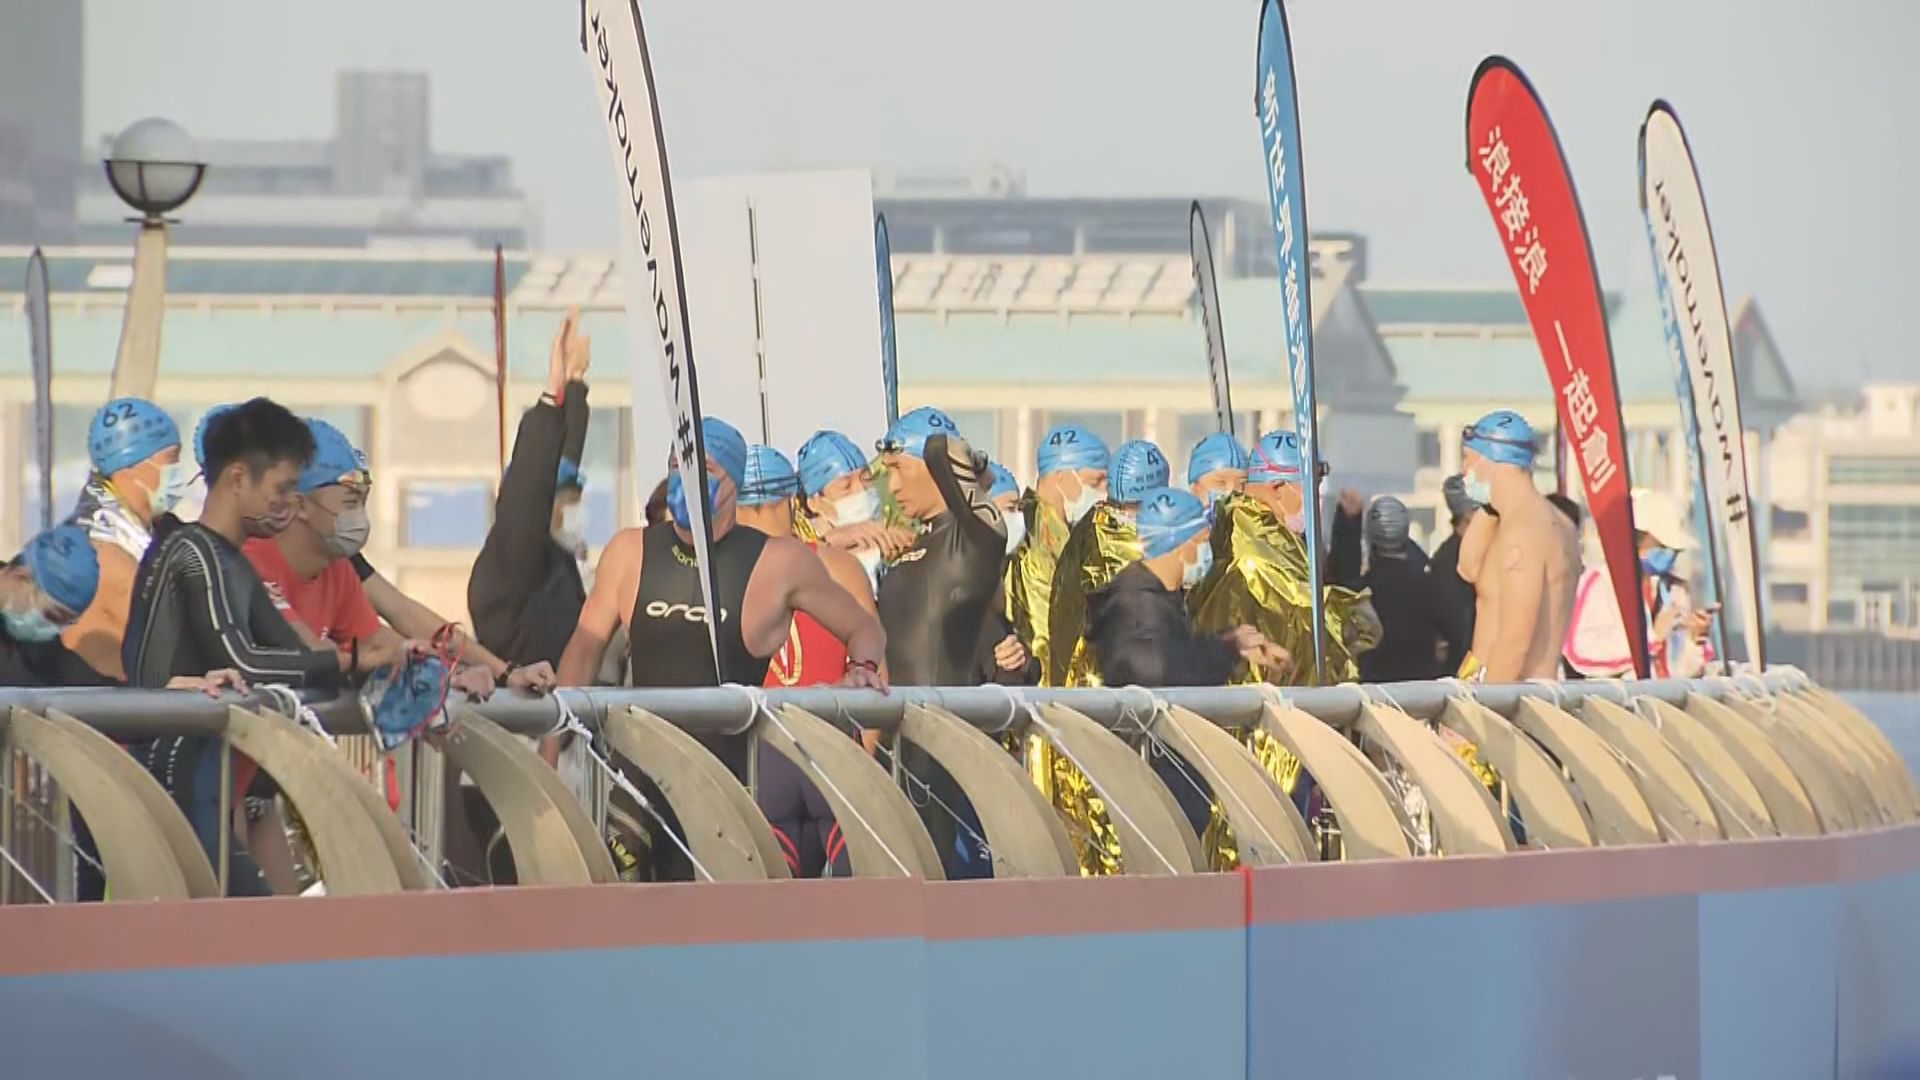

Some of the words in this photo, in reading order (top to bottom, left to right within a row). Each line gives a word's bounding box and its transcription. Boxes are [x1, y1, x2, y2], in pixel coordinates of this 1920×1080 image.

[1479, 126, 1547, 294] 浪接浪
[1554, 320, 1616, 493] 一起創
[102, 402, 138, 428] 62
[1499, 416, 1512, 429] 2
[1048, 430, 1079, 446] 42
